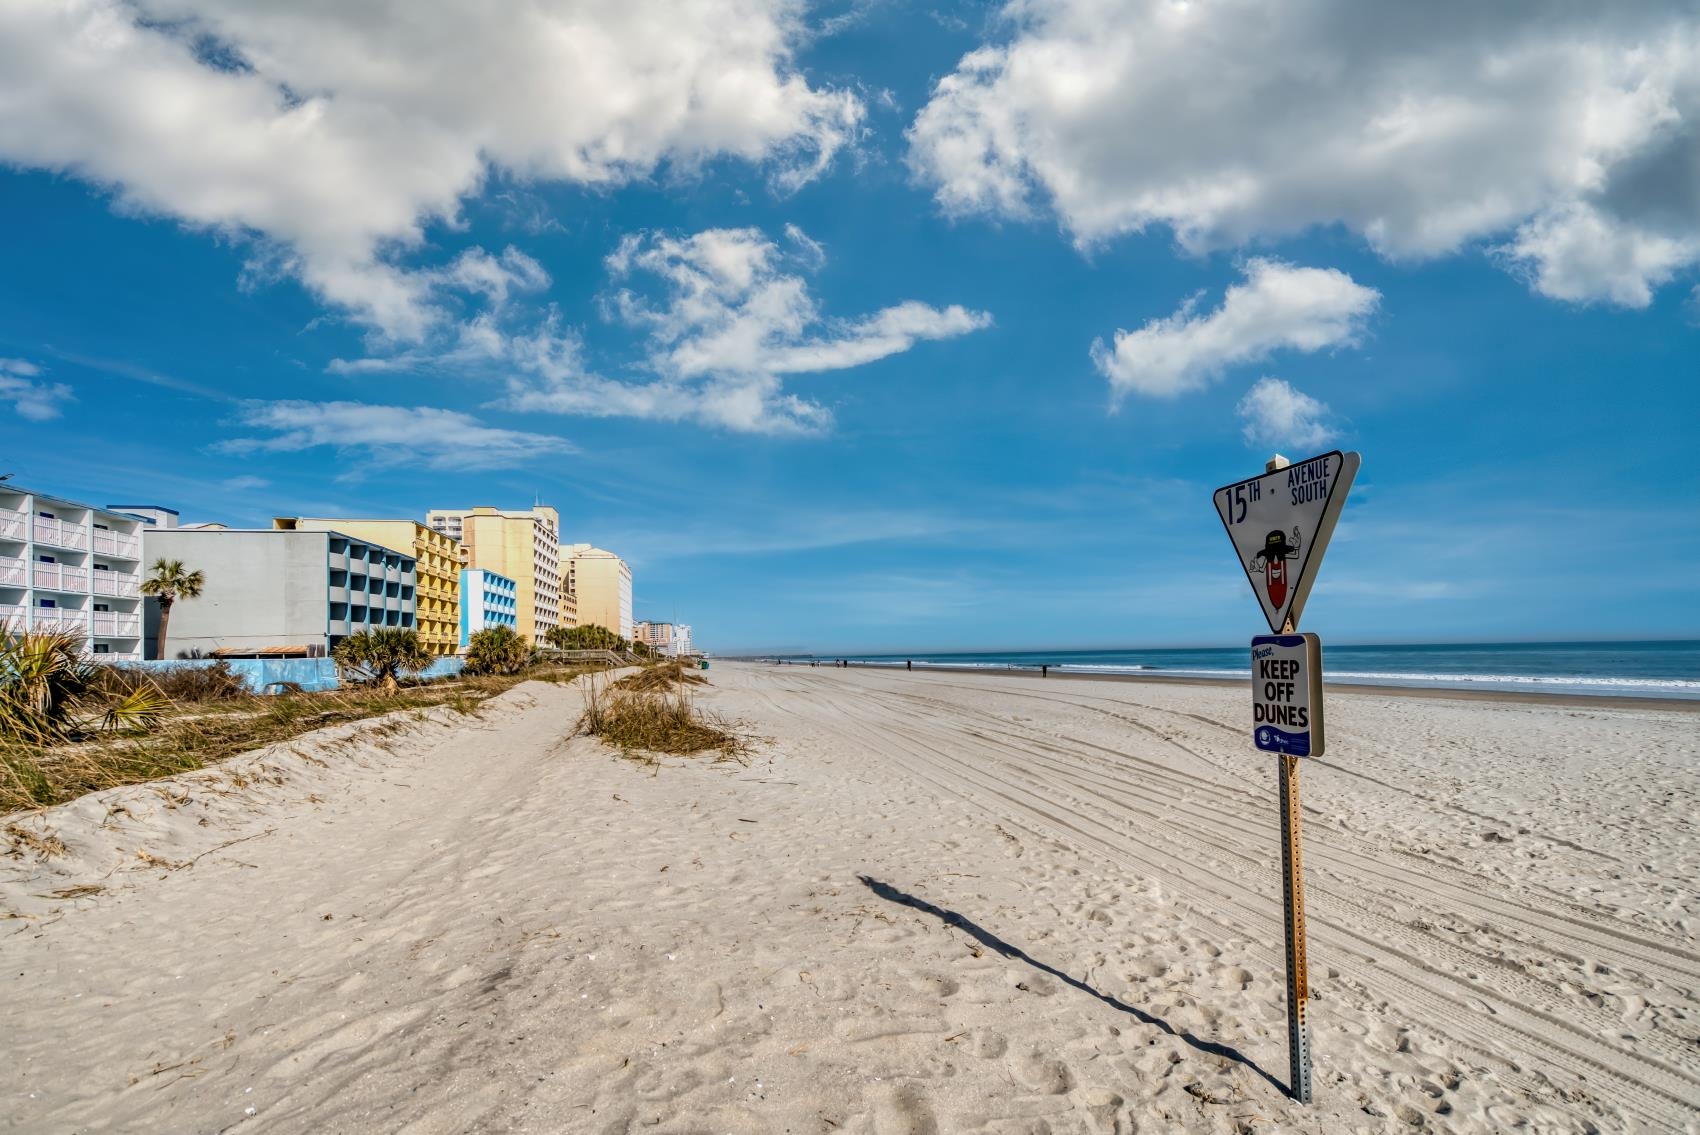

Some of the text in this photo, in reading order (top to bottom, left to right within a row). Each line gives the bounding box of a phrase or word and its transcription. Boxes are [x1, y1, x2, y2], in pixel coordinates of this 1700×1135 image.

[1288, 458, 1329, 488] AVENUE
[1226, 480, 1260, 525] 15TH
[1291, 479, 1327, 506] SOUTH
[1260, 660, 1299, 680] KEEP
[1264, 682, 1294, 702] OFF
[1254, 703, 1308, 727] DUNES
